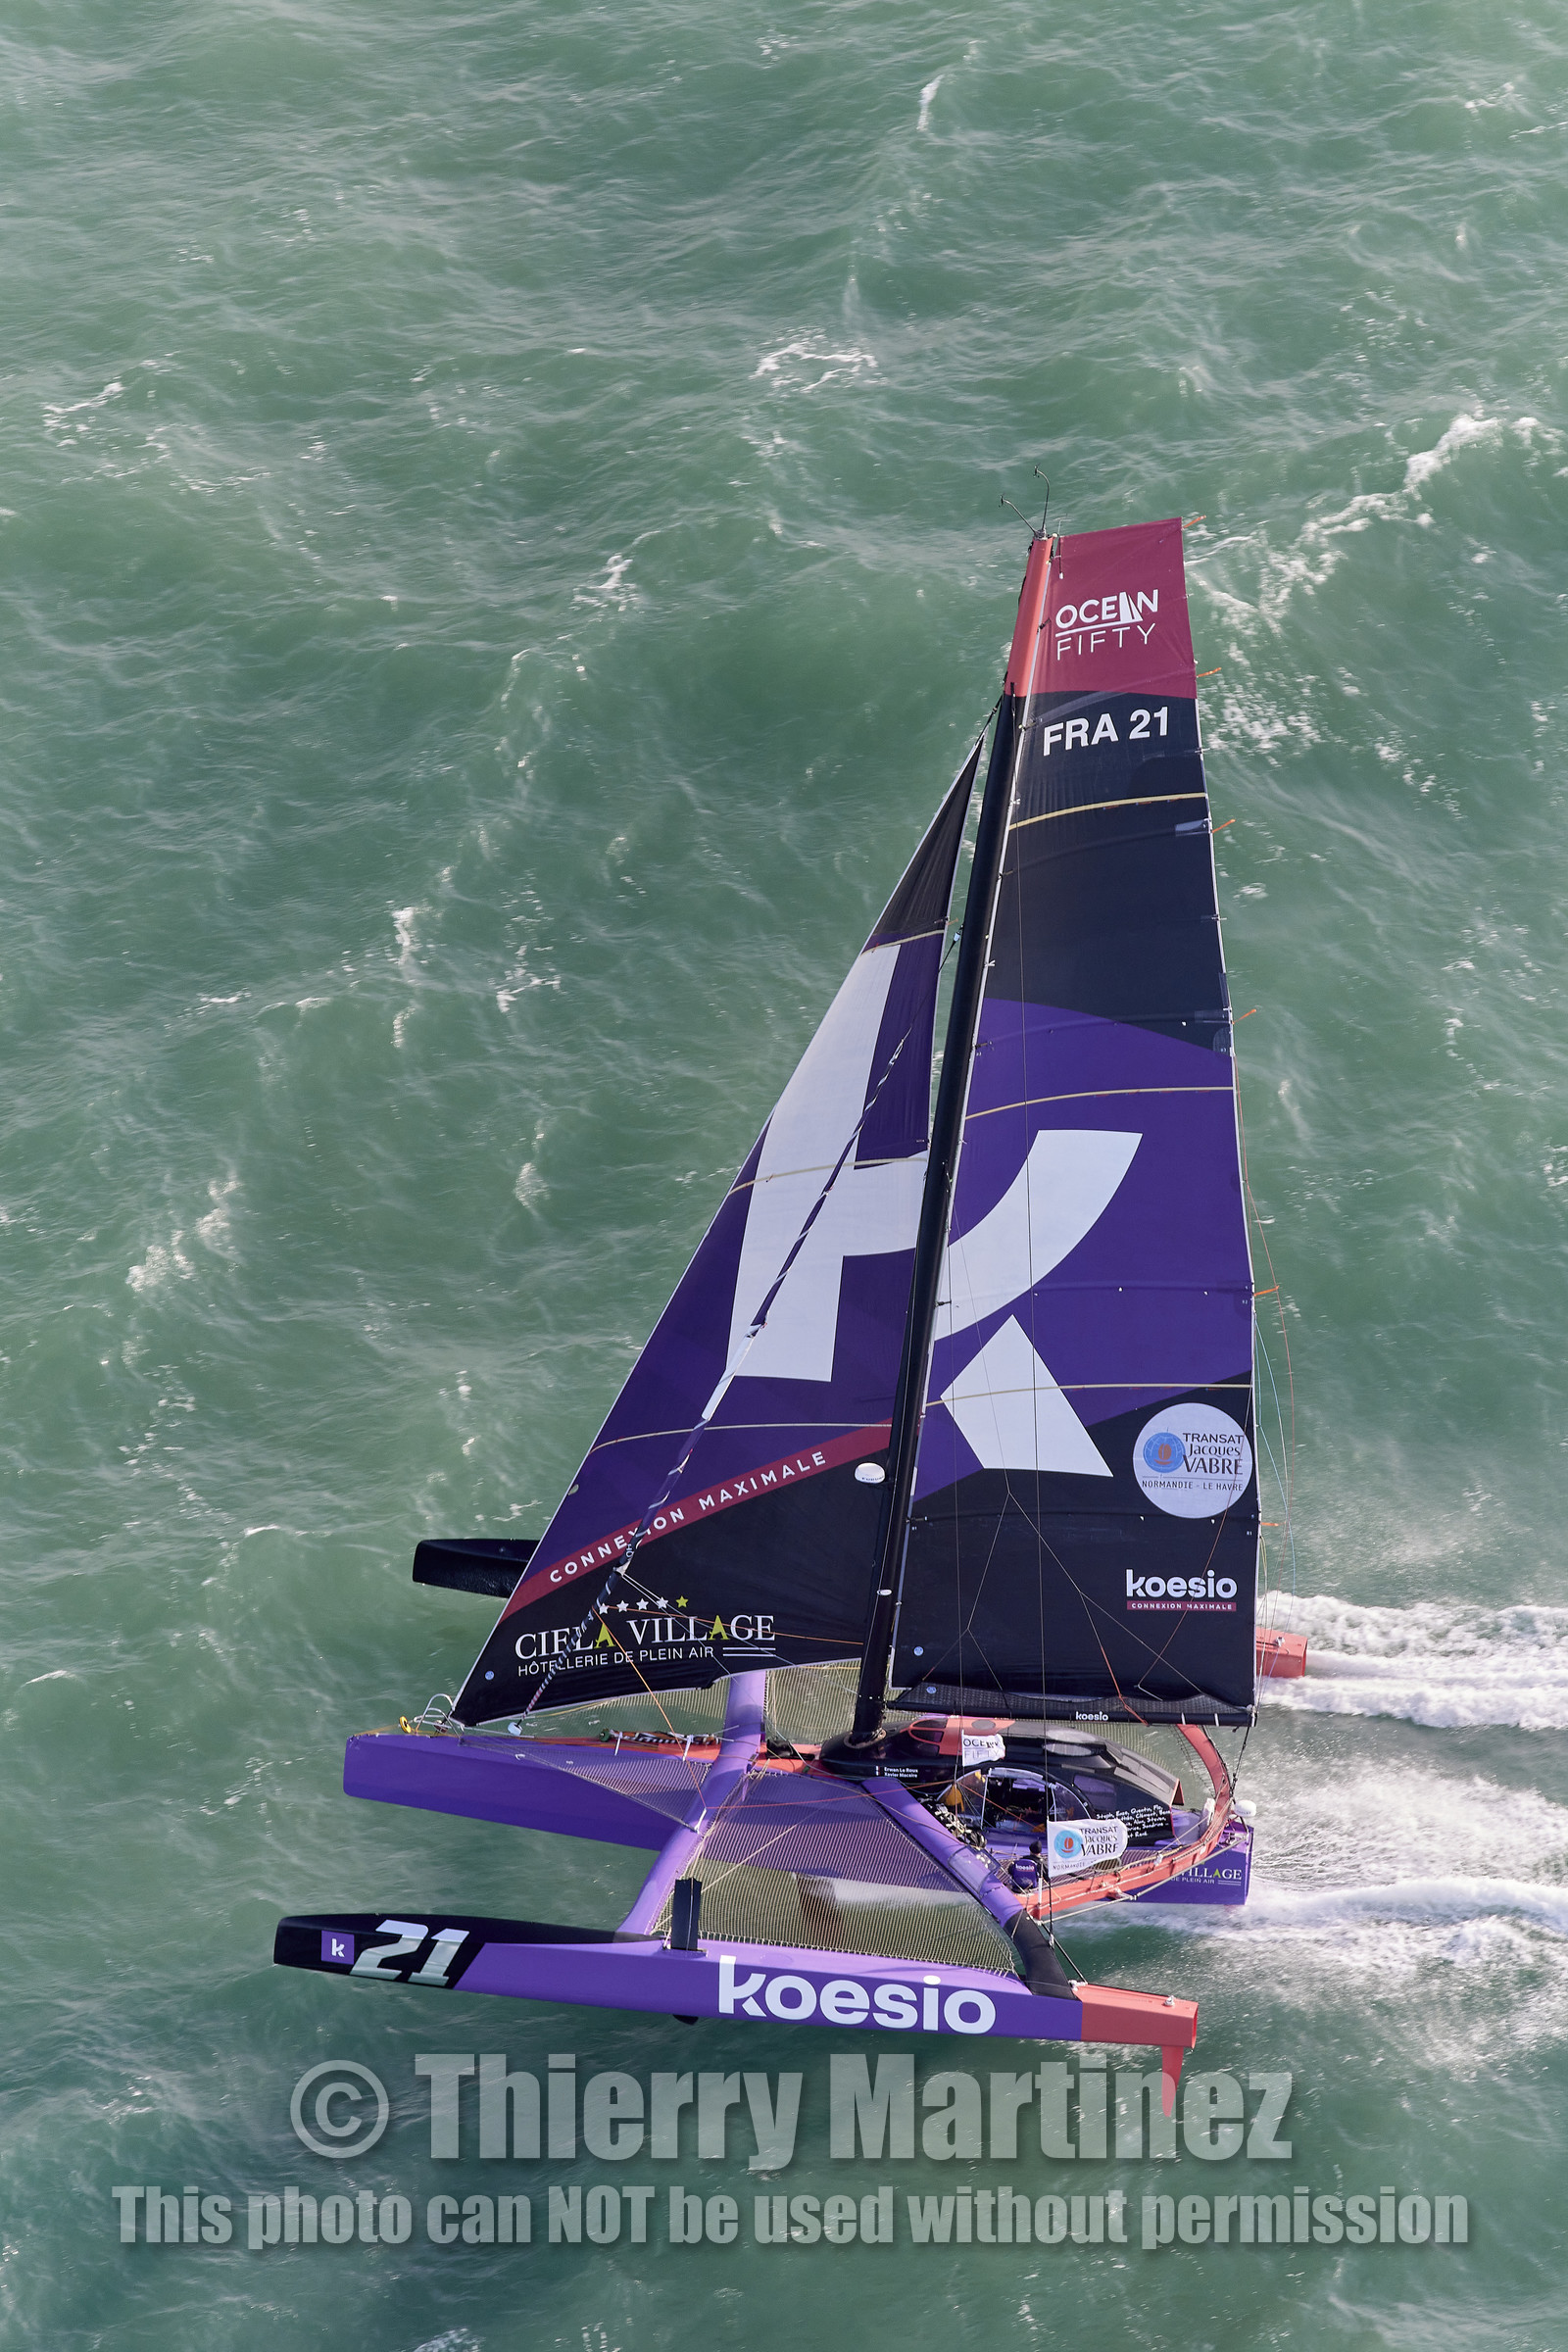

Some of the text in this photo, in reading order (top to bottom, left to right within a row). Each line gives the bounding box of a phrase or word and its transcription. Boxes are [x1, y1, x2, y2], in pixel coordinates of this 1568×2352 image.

[1055, 623, 1156, 661] FIFTY
[1043, 707, 1168, 756] FRA 21
[1182, 1433, 1245, 1444] TRANSAT
[1188, 1444, 1241, 1457] Jacques
[1182, 1454, 1244, 1475] VABRE
[698, 1451, 826, 1510] MAXIMALE
[1142, 1480, 1193, 1489] NORMANDIE
[1126, 1569, 1238, 1598] koesio
[626, 1615, 776, 1645] VILLAGE
[613, 1651, 634, 1663] DE
[640, 1647, 683, 1661] PLEIN
[689, 1646, 714, 1658] AIR
[1075, 1711, 1109, 1721] koesio
[1079, 1826, 1118, 1835] TRANSAT
[349, 1919, 469, 1986] 21
[718, 1955, 997, 2034] koesio
